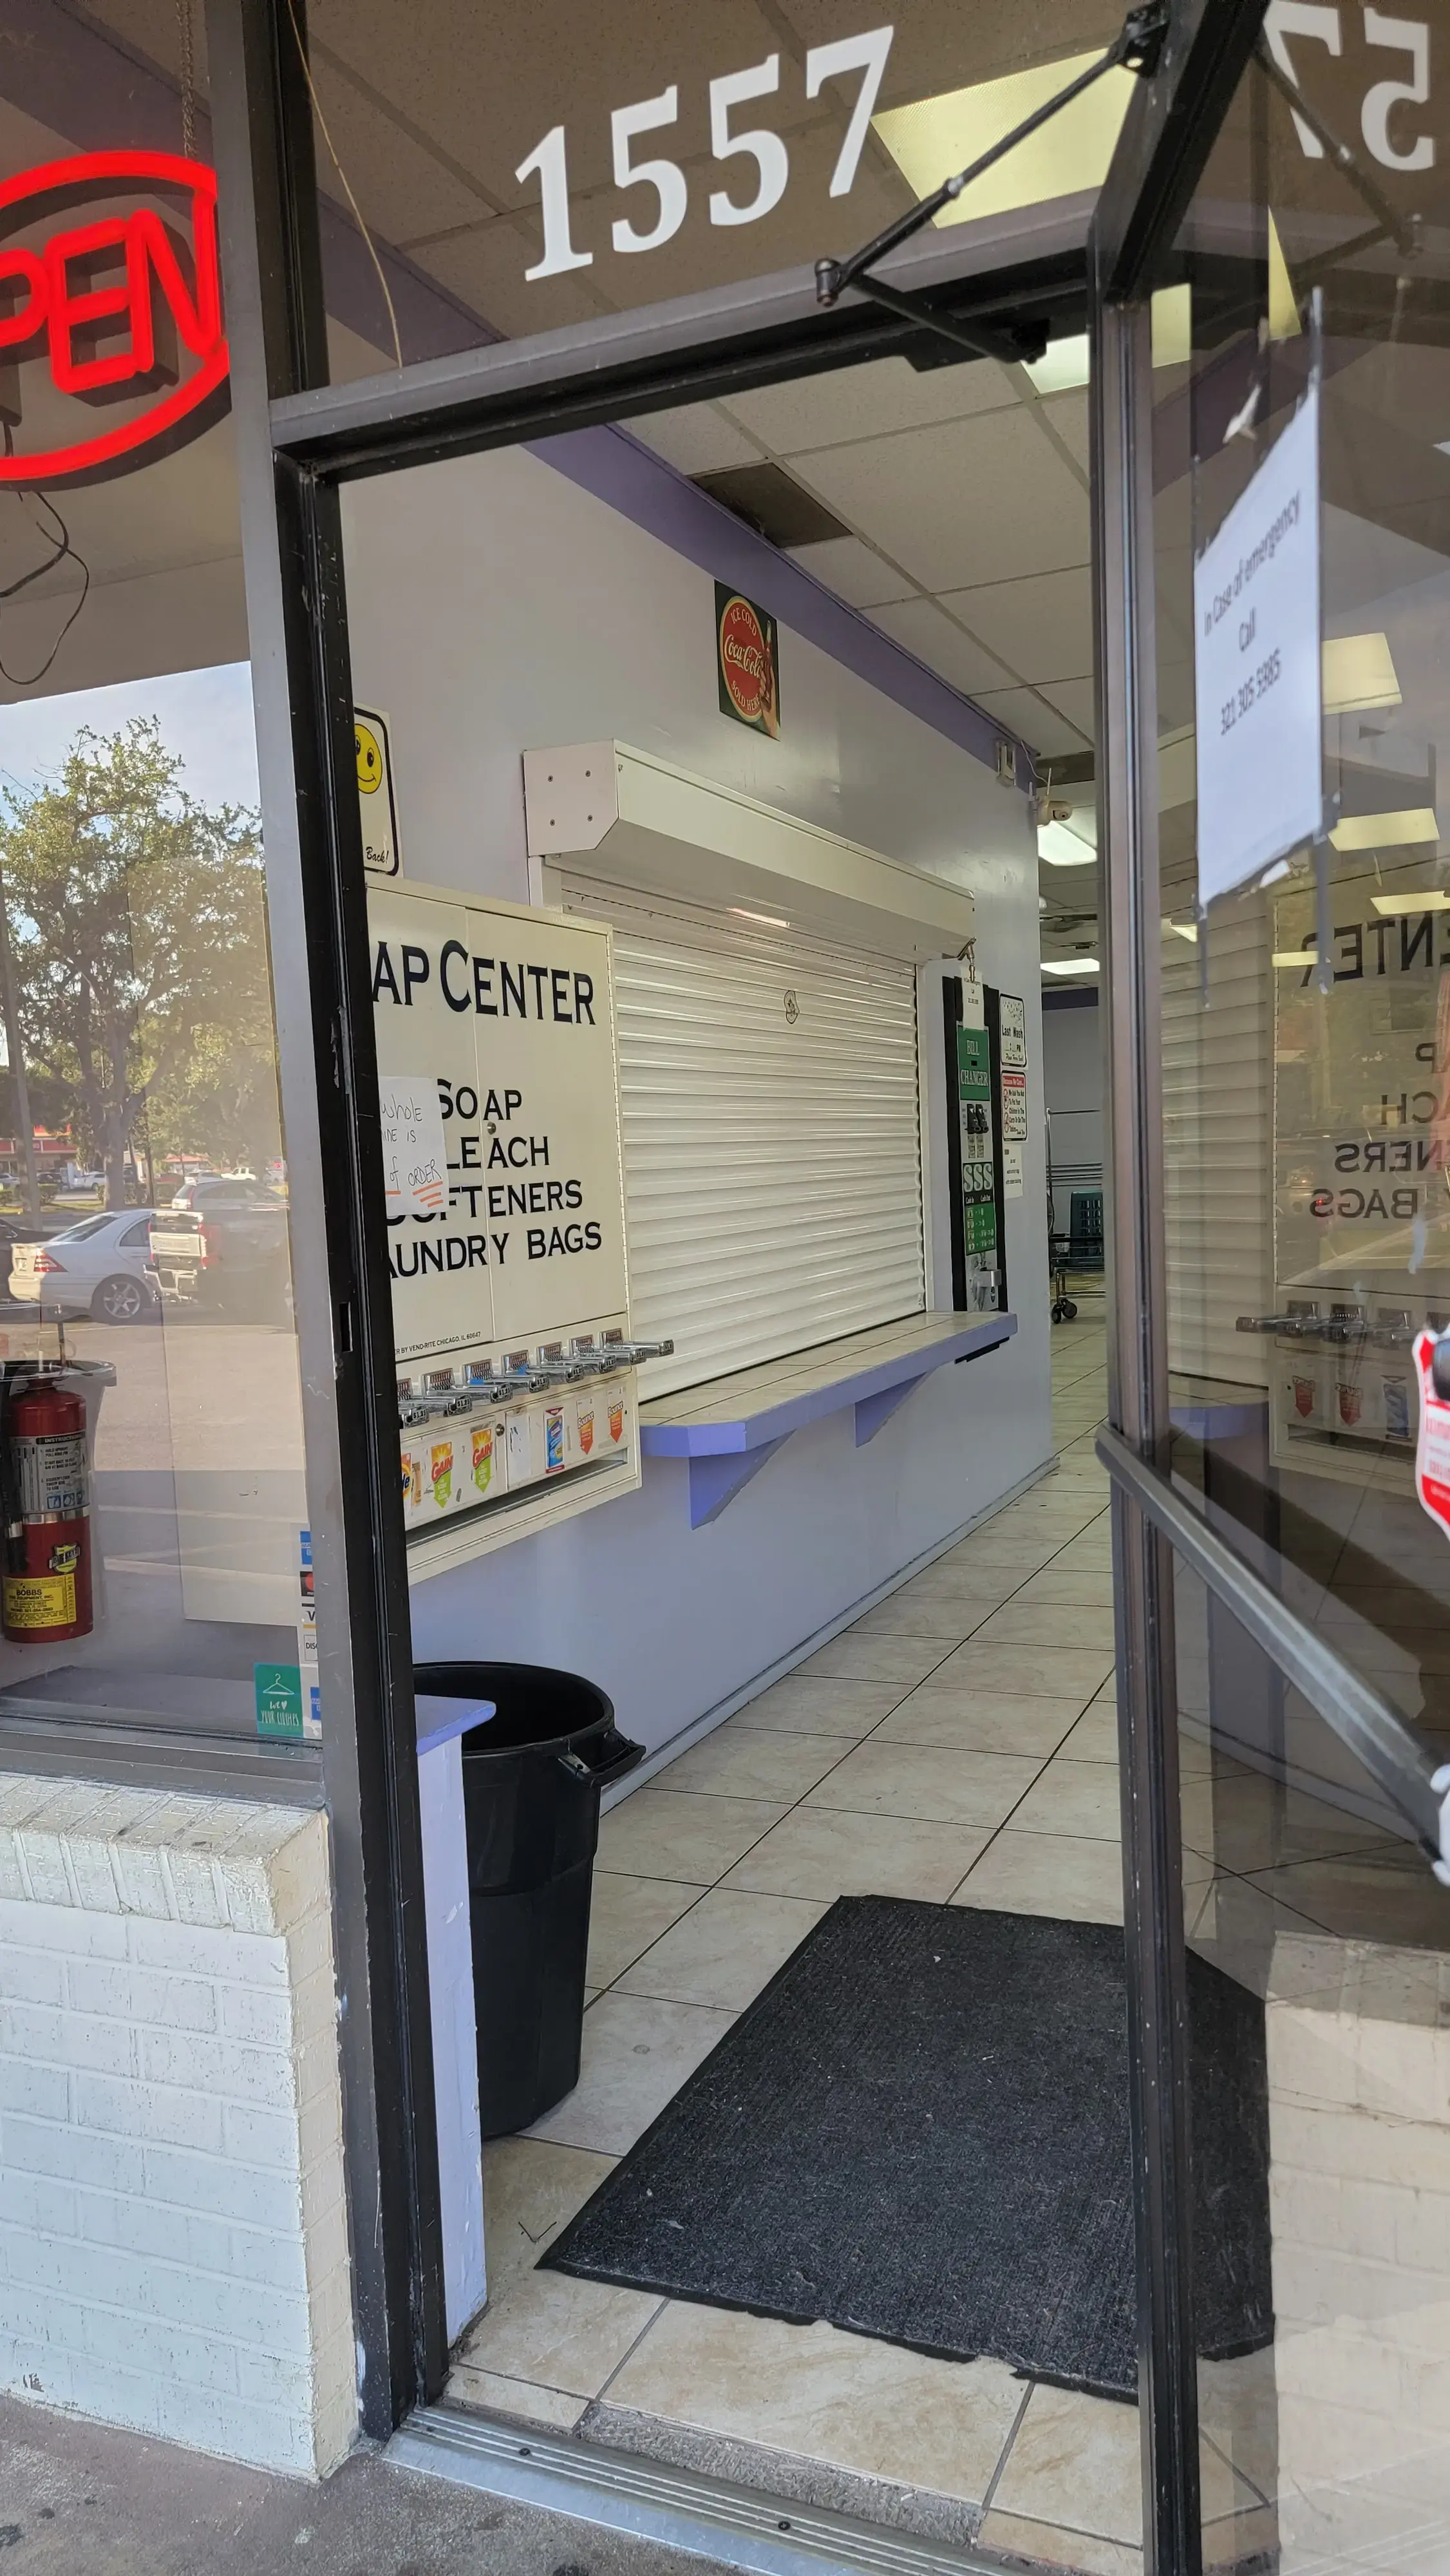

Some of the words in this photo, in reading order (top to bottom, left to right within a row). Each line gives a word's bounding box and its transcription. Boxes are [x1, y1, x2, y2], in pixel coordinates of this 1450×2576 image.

[514, 24, 894, 281] 1557
[1244, 491, 1300, 582] emergency
[731, 607, 742, 625] ICE
[742, 608, 757, 637] COLD
[1238, 606, 1257, 652] Call
[731, 680, 746, 708] SOLD
[366, 846, 389, 864] Back!
[440, 940, 596, 1025] CENTER
[1001, 1025, 1012, 1037] Last
[966, 1039, 980, 1056] BILL
[961, 1069, 988, 1086] CHANGER
[437, 1078, 522, 1121] SOAP
[390, 1156, 399, 1191] of
[408, 1159, 442, 1186] ORDER
[527, 1221, 603, 1260] BAGS
[409, 1341, 437, 1352] VEND-RITE
[437, 1336, 460, 1346] CHICAGO,
[466, 1331, 481, 1340] 60647
[261, 1710, 276, 1724] YOUR
[277, 1711, 299, 1727] CLOTHES
